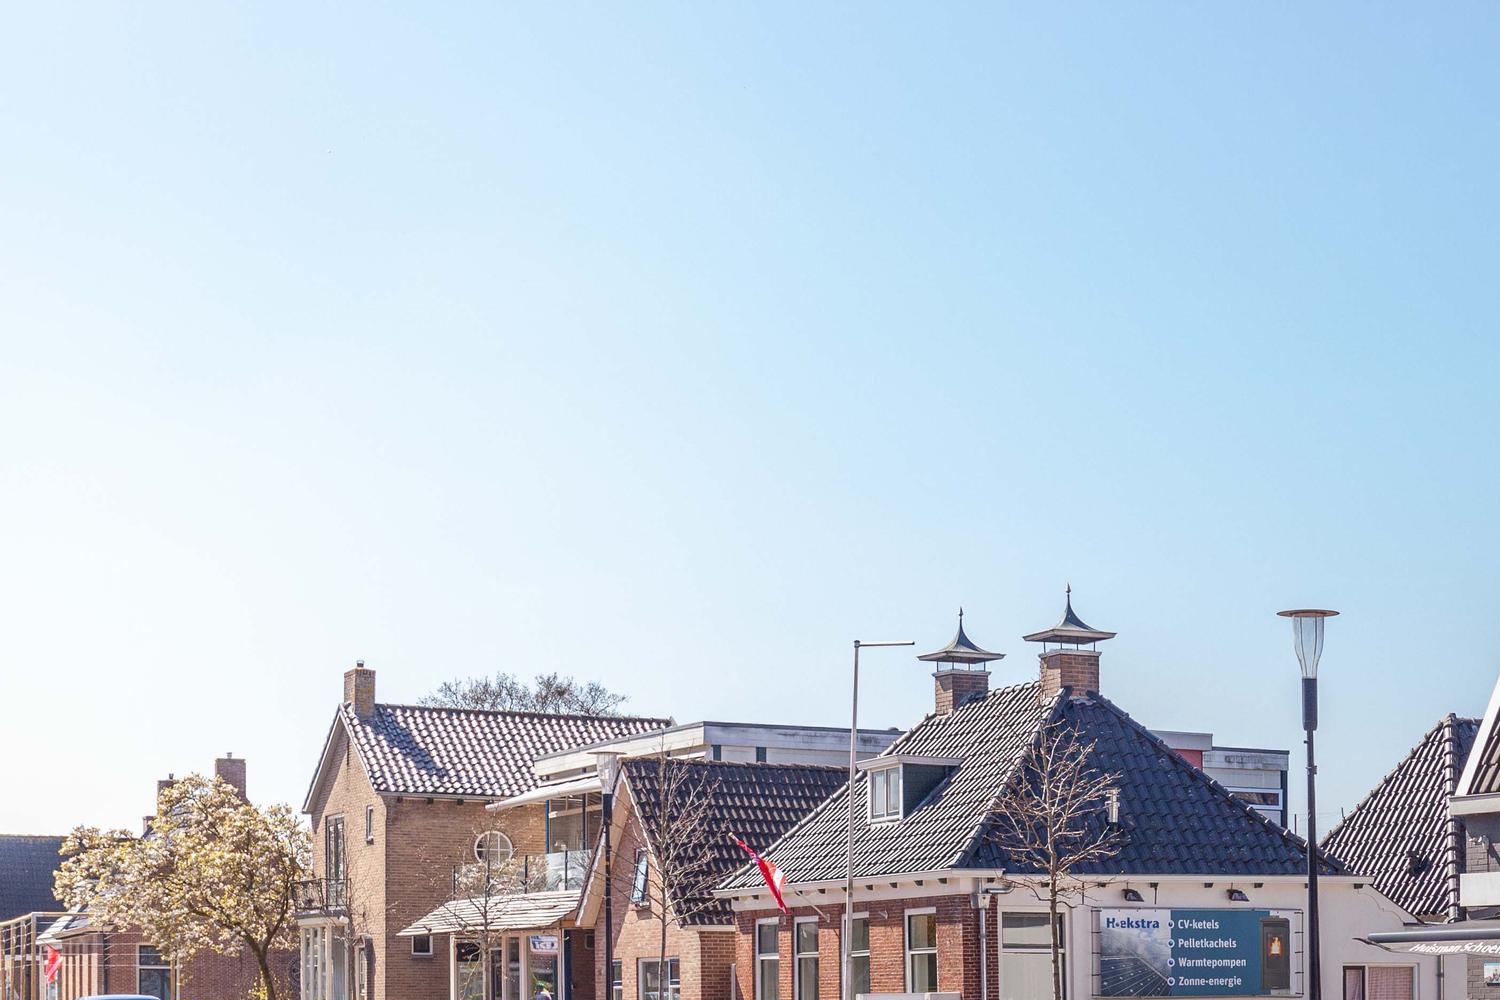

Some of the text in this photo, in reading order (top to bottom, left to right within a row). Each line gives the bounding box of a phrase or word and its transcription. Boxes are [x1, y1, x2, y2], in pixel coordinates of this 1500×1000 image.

[1177, 919, 1220, 930] CV-ketels
[1178, 938, 1237, 949] Pelletkachels
[1408, 943, 1463, 953] Huisman
[1178, 957, 1247, 969] Warmtepompen
[1178, 976, 1242, 988] Zonne-energie
